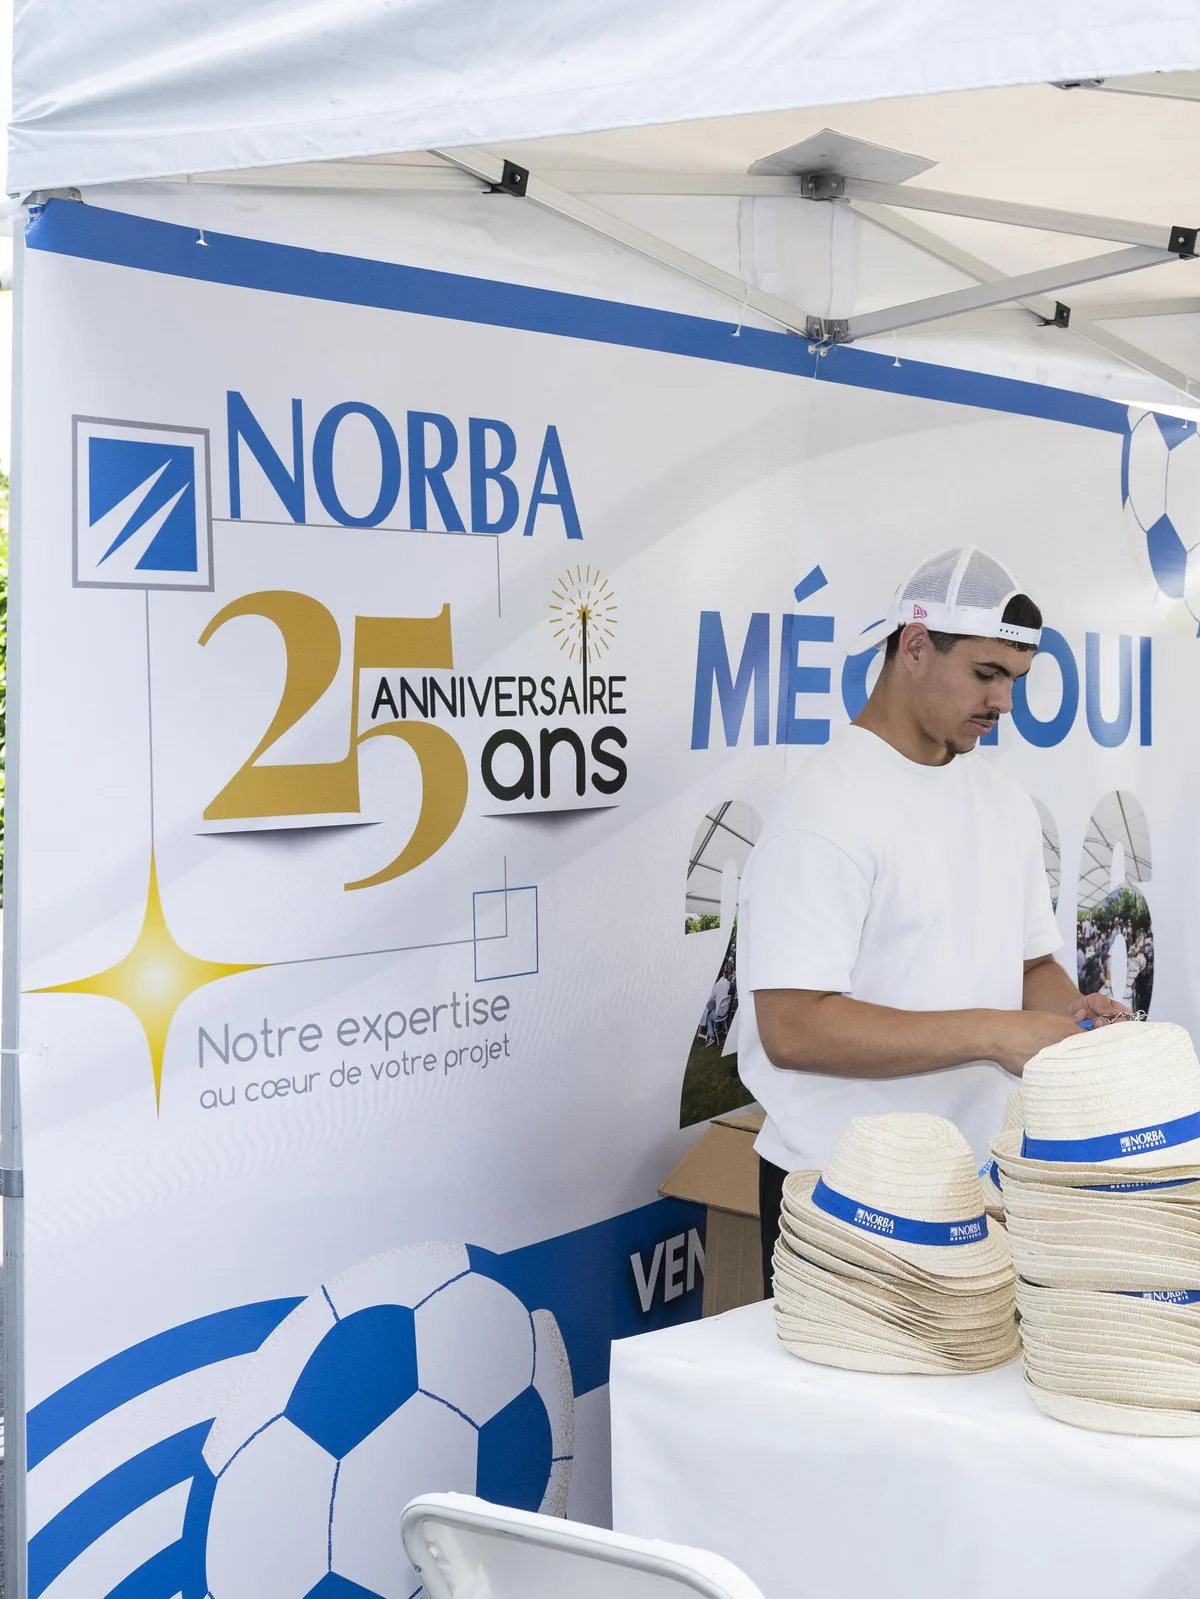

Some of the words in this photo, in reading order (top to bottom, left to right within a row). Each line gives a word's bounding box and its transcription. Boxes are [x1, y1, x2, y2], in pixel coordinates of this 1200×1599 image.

[227, 390, 584, 540] NORBA
[371, 674, 627, 720] ANNIVERSAIRE
[197, 589, 469, 892] 25
[481, 724, 628, 801] ans
[198, 1018, 323, 1069] Notre
[336, 991, 510, 1052] expertise
[199, 1086, 236, 1109] au
[244, 1072, 321, 1102] cœur
[329, 1060, 362, 1088] de
[370, 1050, 437, 1081] votre
[444, 1034, 511, 1076] projet
[1130, 1129, 1166, 1147] NORBA
[863, 1210, 895, 1230] NORBA
[957, 1222, 981, 1237] NORBA
